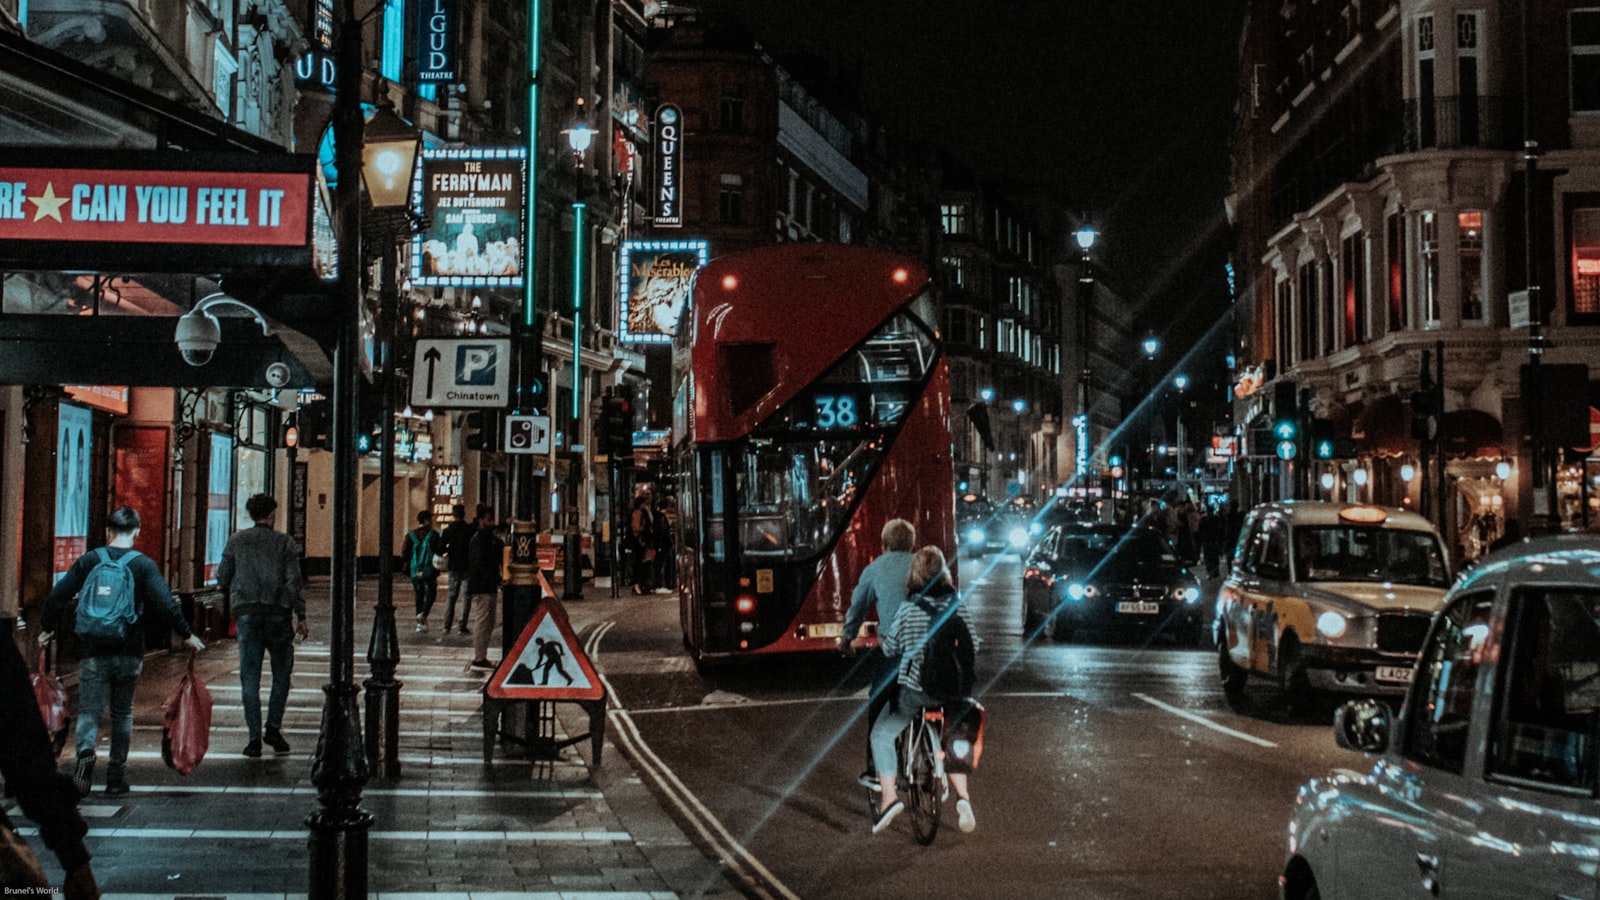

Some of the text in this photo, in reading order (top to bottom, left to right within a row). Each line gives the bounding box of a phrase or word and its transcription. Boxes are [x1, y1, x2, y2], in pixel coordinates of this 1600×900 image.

[420, 71, 454, 79] THEATRE
[464, 162, 481, 172] THE
[660, 125, 677, 217] QUEENS
[432, 174, 512, 191] FERRYMAN
[71, 183, 127, 222] CAN
[135, 185, 188, 224] YOU
[196, 187, 249, 226] FEEL
[258, 189, 285, 227] IT
[446, 391, 500, 400] Chinatown
[816, 397, 855, 427] 38
